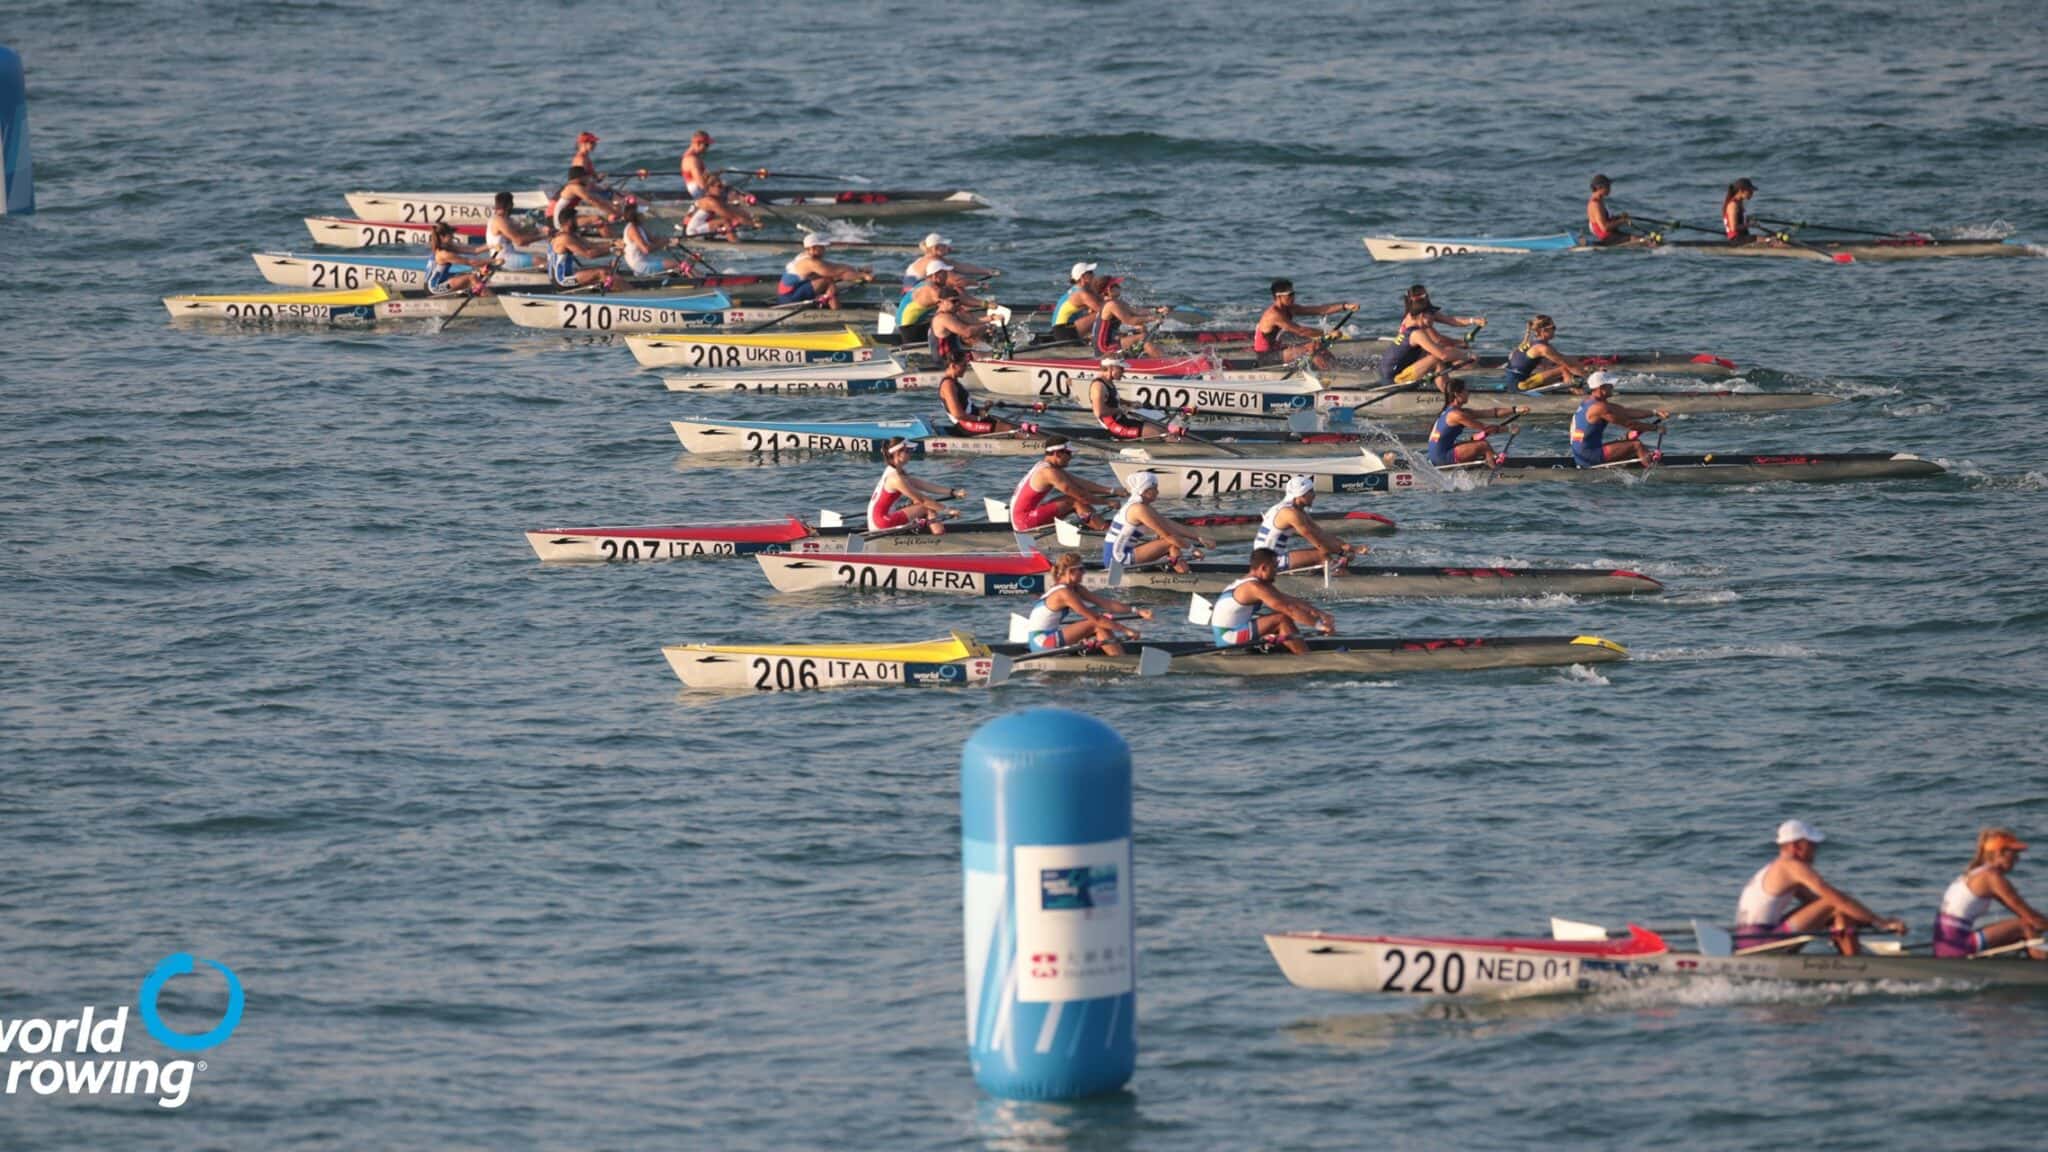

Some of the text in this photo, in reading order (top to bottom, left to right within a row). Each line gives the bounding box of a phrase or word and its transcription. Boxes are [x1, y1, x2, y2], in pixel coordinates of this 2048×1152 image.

[402, 203, 446, 223] 212
[450, 207, 481, 218] FRA
[311, 264, 417, 289] 216 FRA 02
[563, 303, 677, 330] 210 RUS 01
[690, 344, 802, 368] 208 UKR 01
[1197, 390, 1234, 408] SWE
[1239, 392, 1259, 408] 01
[808, 435, 846, 450] FRA
[850, 438, 869, 452] 03
[1185, 470, 1243, 498] 214
[1250, 473, 1290, 488] ESP
[600, 539, 661, 560] 207
[668, 541, 705, 558] ITA
[752, 658, 899, 690] 206 ITA 01
[1382, 949, 1571, 993] 220 NED 01
